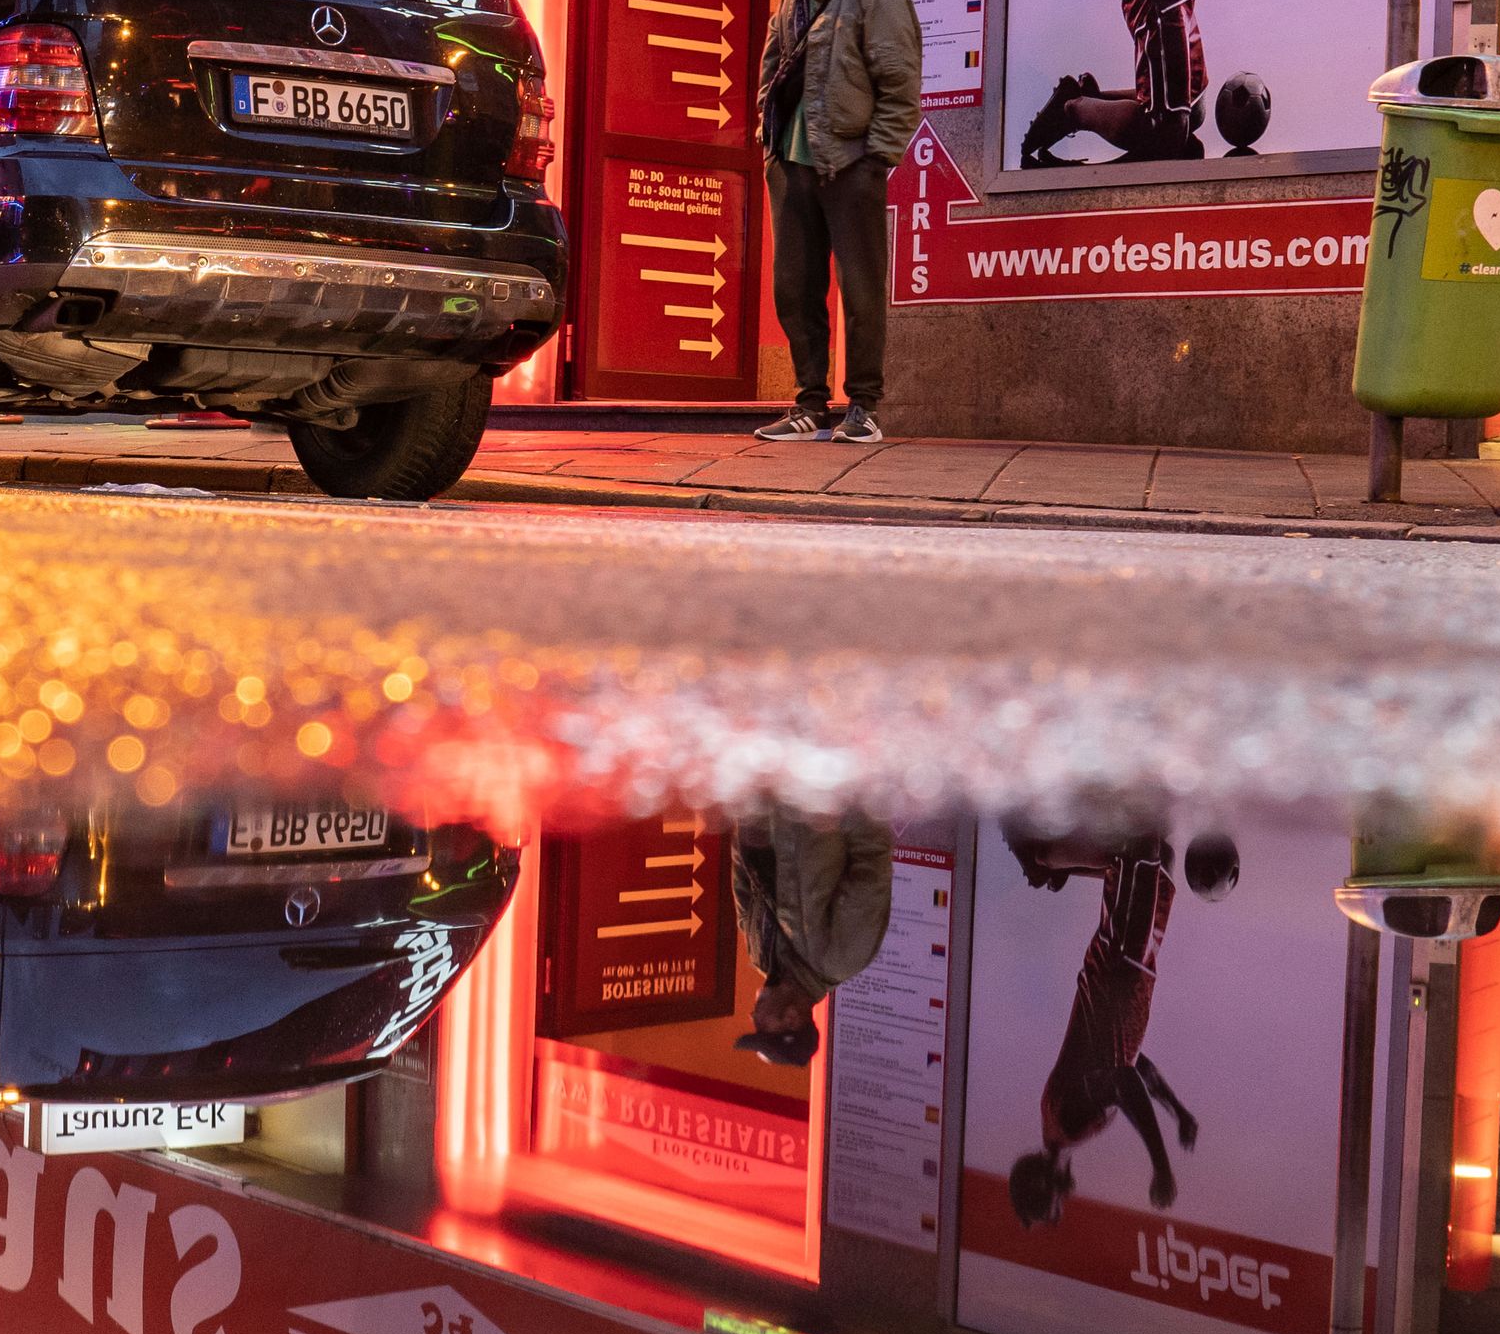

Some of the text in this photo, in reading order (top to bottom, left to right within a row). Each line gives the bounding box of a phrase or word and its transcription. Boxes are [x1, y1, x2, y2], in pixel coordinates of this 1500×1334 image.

[252, 82, 271, 114] F
[292, 85, 331, 125] BB
[337, 90, 408, 129] 6650
[921, 94, 975, 109] shaus.com
[650, 170, 664, 183] DO
[678, 175, 688, 185] 10
[705, 177, 723, 190] Uhr
[628, 182, 641, 194] FR
[642, 185, 652, 195] 10
[683, 188, 701, 200] Uhr
[701, 191, 723, 204] (24h)
[628, 196, 722, 216] durchgehend geöffnet
[910, 136, 935, 295] GIRLS
[967, 231, 1371, 280] www.roteshaus.com
